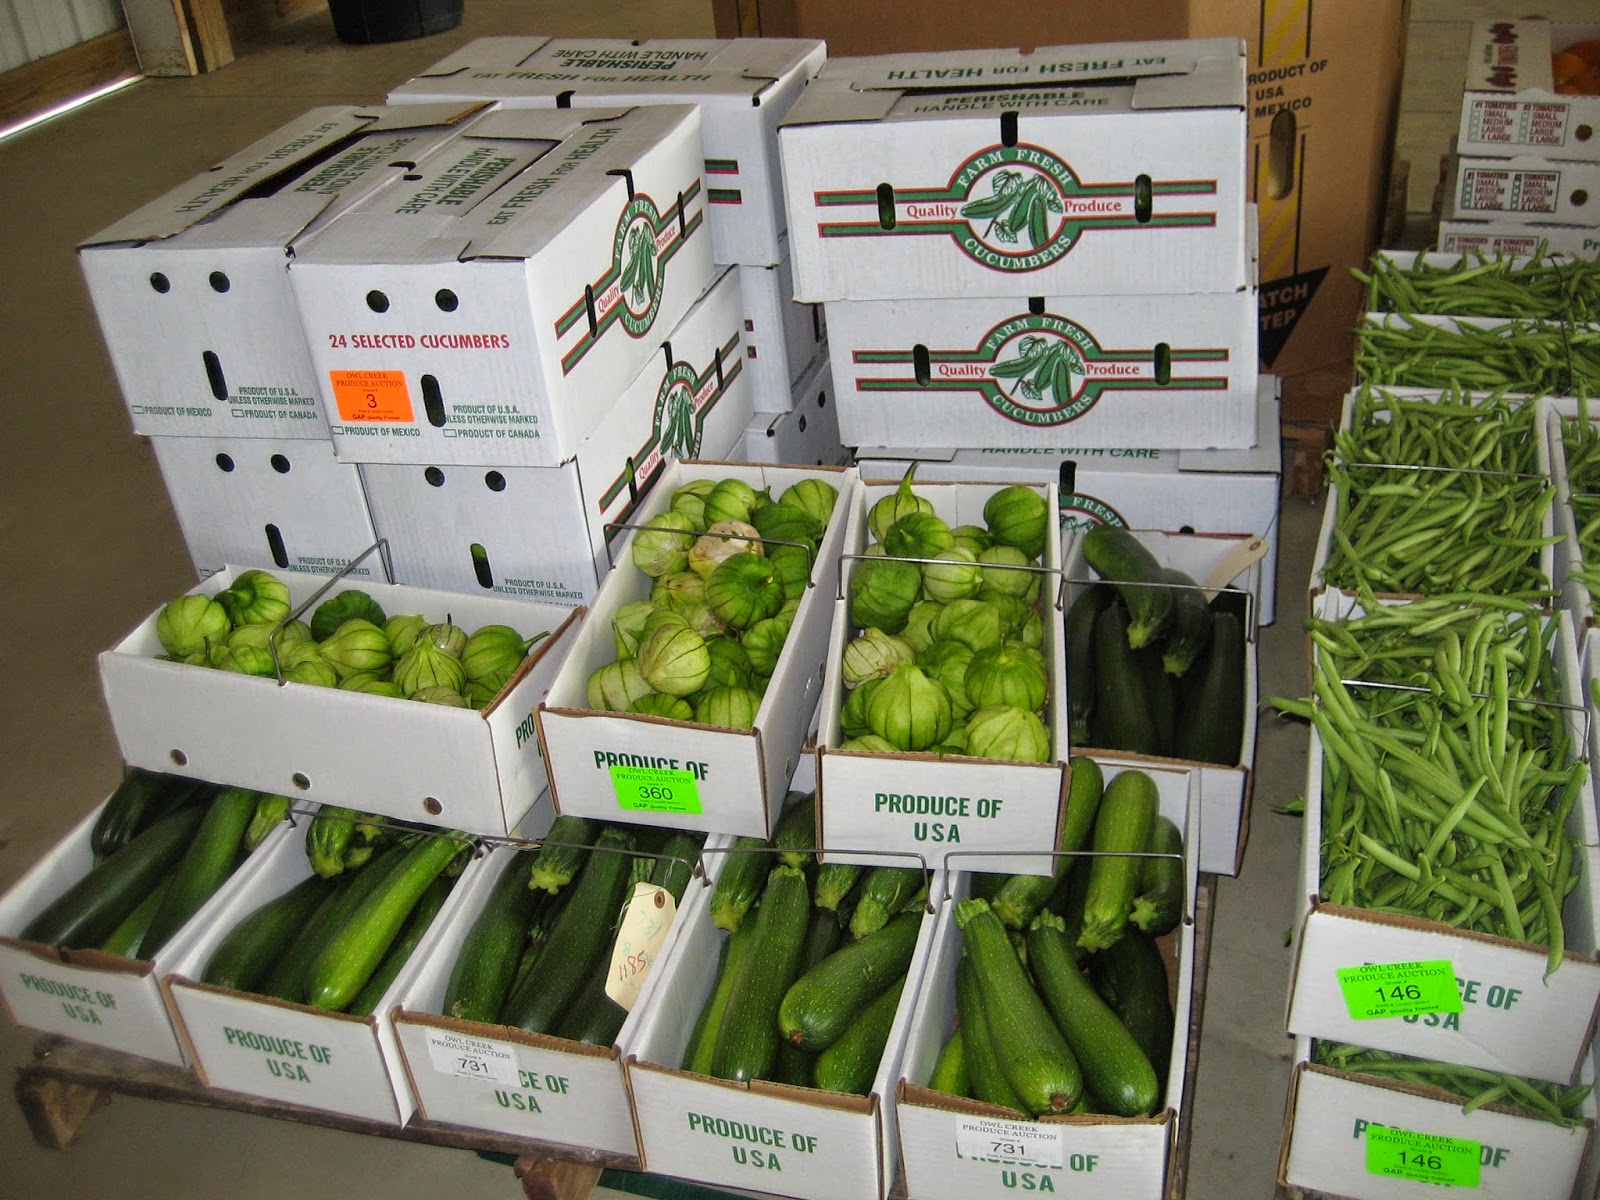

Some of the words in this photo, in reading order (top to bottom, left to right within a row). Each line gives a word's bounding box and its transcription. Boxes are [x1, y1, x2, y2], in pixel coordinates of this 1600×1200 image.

[552, 49, 597, 58] CARE
[601, 50, 635, 59] WITH
[640, 51, 708, 61] HANDLE
[560, 60, 678, 70] PERISHABLE
[1040, 60, 1124, 74] FRESH
[1134, 57, 1167, 66] EAT
[504, 72, 579, 80] FRESH
[619, 74, 713, 82] HEALTH
[887, 67, 984, 80] HEALTH
[992, 66, 1030, 75] FOR
[1247, 64, 1306, 85] RODUCT
[1309, 60, 1328, 74] OF
[944, 91, 1086, 104] PERISHABLE
[1255, 86, 1284, 101] USA
[913, 101, 996, 113] HANDLE
[1000, 100, 1051, 109] WITH
[1054, 98, 1111, 107] CARE
[1255, 97, 1312, 118] MEXICO
[1484, 101, 1518, 110] TOMATOES
[1532, 103, 1567, 112] TOMATOES
[1483, 110, 1508, 118] SMALL
[1532, 112, 1558, 120] SMALL
[1482, 118, 1514, 126] MEDIUM
[1531, 120, 1563, 128] MEDIUM
[1530, 128, 1555, 136] LARGE
[564, 128, 622, 160] HEALTH
[453, 147, 499, 174] HANDLE
[956, 150, 1005, 188] FARM
[1016, 148, 1075, 185] FRESH
[550, 160, 580, 178] FOR
[423, 173, 461, 193] WITH
[435, 157, 518, 206] PERISHABLE
[176, 176, 242, 213] HEALTH
[500, 176, 559, 209] FRESH
[395, 192, 437, 215] CARE
[906, 203, 958, 219] Quality
[1064, 200, 1122, 214] Produce
[487, 211, 517, 226] EAT
[634, 201, 658, 226] FRESH
[963, 234, 1073, 270] CUCUMBERS
[598, 285, 620, 314] Quality
[656, 225, 677, 252] Produce
[1261, 308, 1297, 330] TEP
[986, 318, 1029, 350] FARM
[1041, 317, 1096, 350] FRESH
[328, 335, 347, 348] 24
[351, 334, 416, 348] SELECTED
[420, 334, 511, 349] CUCUMBERS
[673, 366, 696, 385] FRESH
[938, 364, 987, 378] Quality
[1086, 363, 1140, 375] Produce
[238, 387, 268, 396] PRODUCT
[269, 388, 278, 396] OF
[279, 388, 299, 397] U.S.A.
[227, 396, 251, 404] UNLESS
[252, 396, 288, 405] OTHERWISE
[288, 397, 315, 406] MARKED
[366, 393, 378, 409] 3
[144, 406, 177, 415] PRODUCT
[177, 407, 186, 415] OF
[186, 408, 213, 417] MEXICO
[245, 410, 277, 418] PRODUCT
[279, 410, 288, 419] OF
[289, 411, 318, 420] CANADA
[453, 405, 485, 414] PRODUCT
[486, 405, 496, 414] OF
[497, 406, 520, 414] U.S.A.
[992, 394, 1093, 424] CUCUMBERS
[467, 415, 507, 424] OTHERWISE
[508, 416, 538, 424] MARKED
[345, 426, 380, 435] PRODUCT
[381, 427, 391, 435] OF
[392, 427, 420, 437] MEXICO
[457, 429, 494, 438] PRODUCT
[496, 429, 506, 438] OF
[508, 430, 540, 439] CANADA
[639, 450, 660, 480] Quality
[694, 381, 715, 407] Produce
[1060, 448, 1104, 456] WITH
[1110, 448, 1161, 459] CARE
[298, 557, 327, 566] PRODUCT
[327, 558, 336, 566] OF
[504, 578, 535, 588] PRODUCT
[537, 580, 545, 588] OF
[546, 581, 567, 590] U.S.A.
[493, 586, 517, 595] UNLESS
[519, 588, 555, 597] OTHERWISE
[555, 590, 583, 599] MARKED
[593, 750, 679, 771] PRODUCE
[686, 761, 709, 781] OF
[616, 773, 655, 781] PRODUCE
[655, 776, 692, 784] AUCTION
[638, 786, 673, 800] 360
[875, 793, 971, 817] PRODUCE
[976, 799, 1003, 819] OF
[914, 822, 961, 843] USA
[1359, 964, 1386, 973] OWL
[1386, 962, 1424, 972] CREEK
[1343, 971, 1398, 984] PRODUCE
[1398, 968, 1446, 978] AUCTION
[20, 973, 93, 1005] PRODUCE
[95, 990, 117, 1010] OF
[1374, 984, 1422, 1002] 146
[1486, 984, 1523, 1011] OF
[61, 1002, 103, 1025] USA
[1366, 1008, 1387, 1016] GAP
[223, 1027, 308, 1060] PRODUCE
[309, 1044, 332, 1066] OF
[431, 1039, 474, 1053] PRODUCE
[474, 1048, 511, 1060] AUCTION
[445, 1035, 465, 1045] OWL
[465, 1040, 494, 1050] CREEK
[266, 1059, 312, 1083] USA
[457, 1058, 489, 1074] 731
[545, 1074, 570, 1095] OF
[495, 1089, 543, 1114] USA
[687, 1112, 786, 1149] PRODUCE
[791, 1133, 818, 1154] OF
[962, 1124, 1010, 1136] PRODUCE
[1012, 1131, 1058, 1141] AUCTION
[980, 1120, 1003, 1130] OWL
[1004, 1124, 1039, 1133] CREEK
[1371, 1133, 1422, 1147] PRODUCE
[1424, 1143, 1474, 1154] AUCTION
[1390, 1129, 1413, 1139] OWL
[1413, 1132, 1454, 1144] CREEK
[990, 1141, 1026, 1156] 731
[732, 1145, 782, 1171] USA
[1069, 1153, 1100, 1173] OF
[1397, 1151, 1442, 1170] 146
[1480, 1145, 1510, 1168] OF
[1383, 1167, 1404, 1175] GAP
[1001, 1170, 1055, 1192] USA
